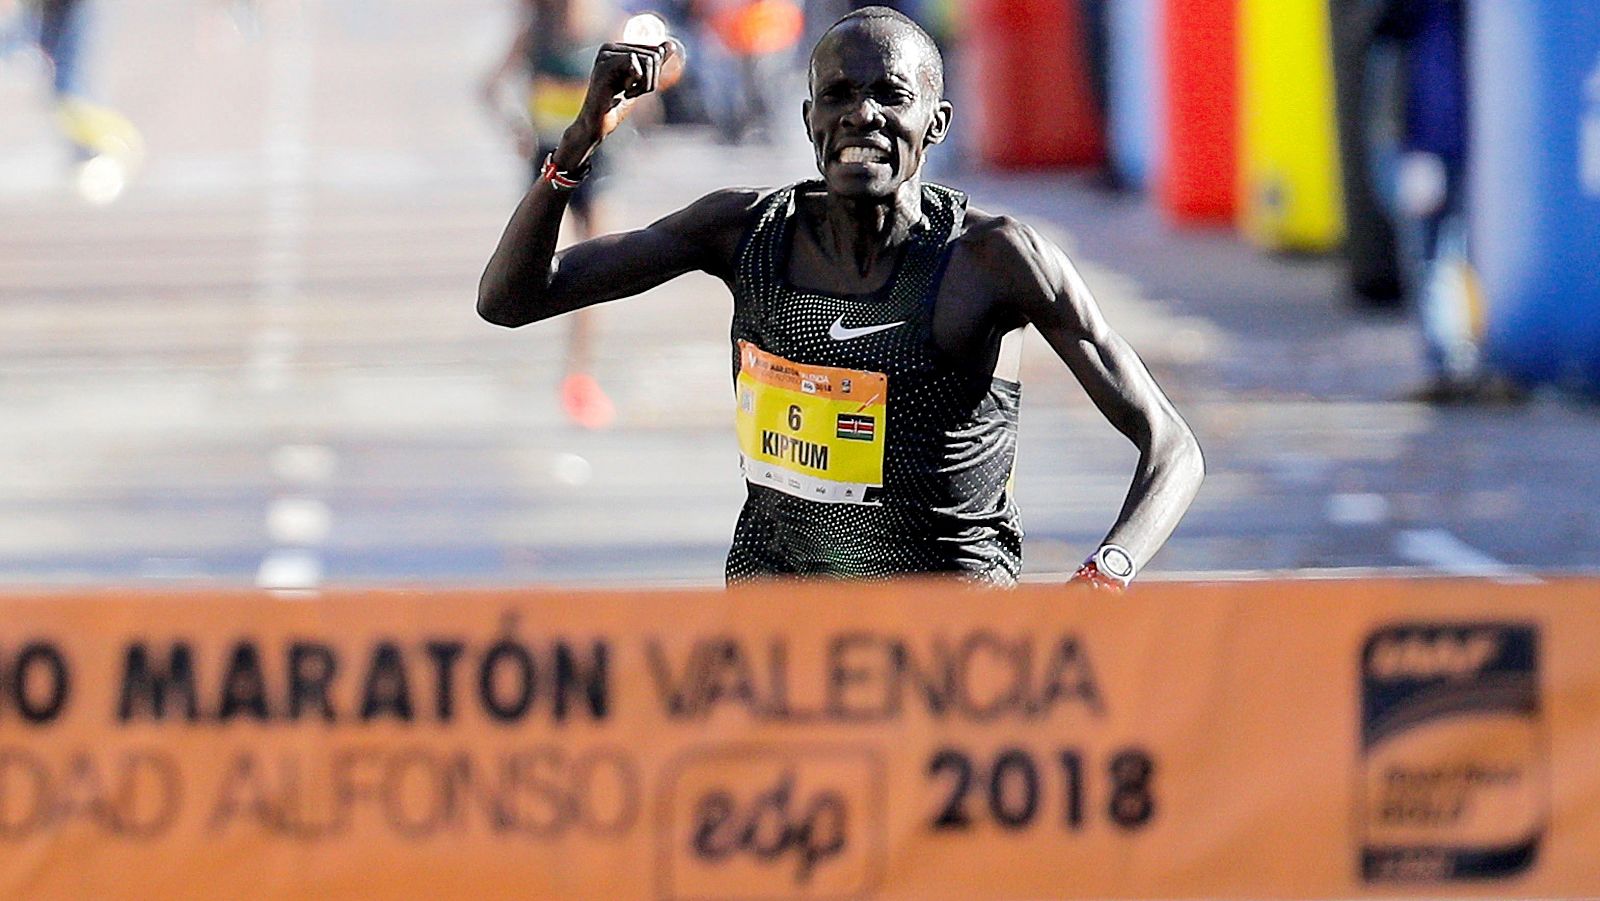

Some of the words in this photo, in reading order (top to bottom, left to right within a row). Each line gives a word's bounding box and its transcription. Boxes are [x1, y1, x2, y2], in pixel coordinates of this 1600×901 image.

[762, 430, 829, 471] KIPTUM
[788, 404, 802, 431] 6
[0, 636, 71, 727] O
[118, 610, 609, 726] MARATÓN
[643, 631, 1106, 723] VALENCIA
[207, 748, 642, 841] ALFONSO
[929, 748, 1156, 832] 2018
